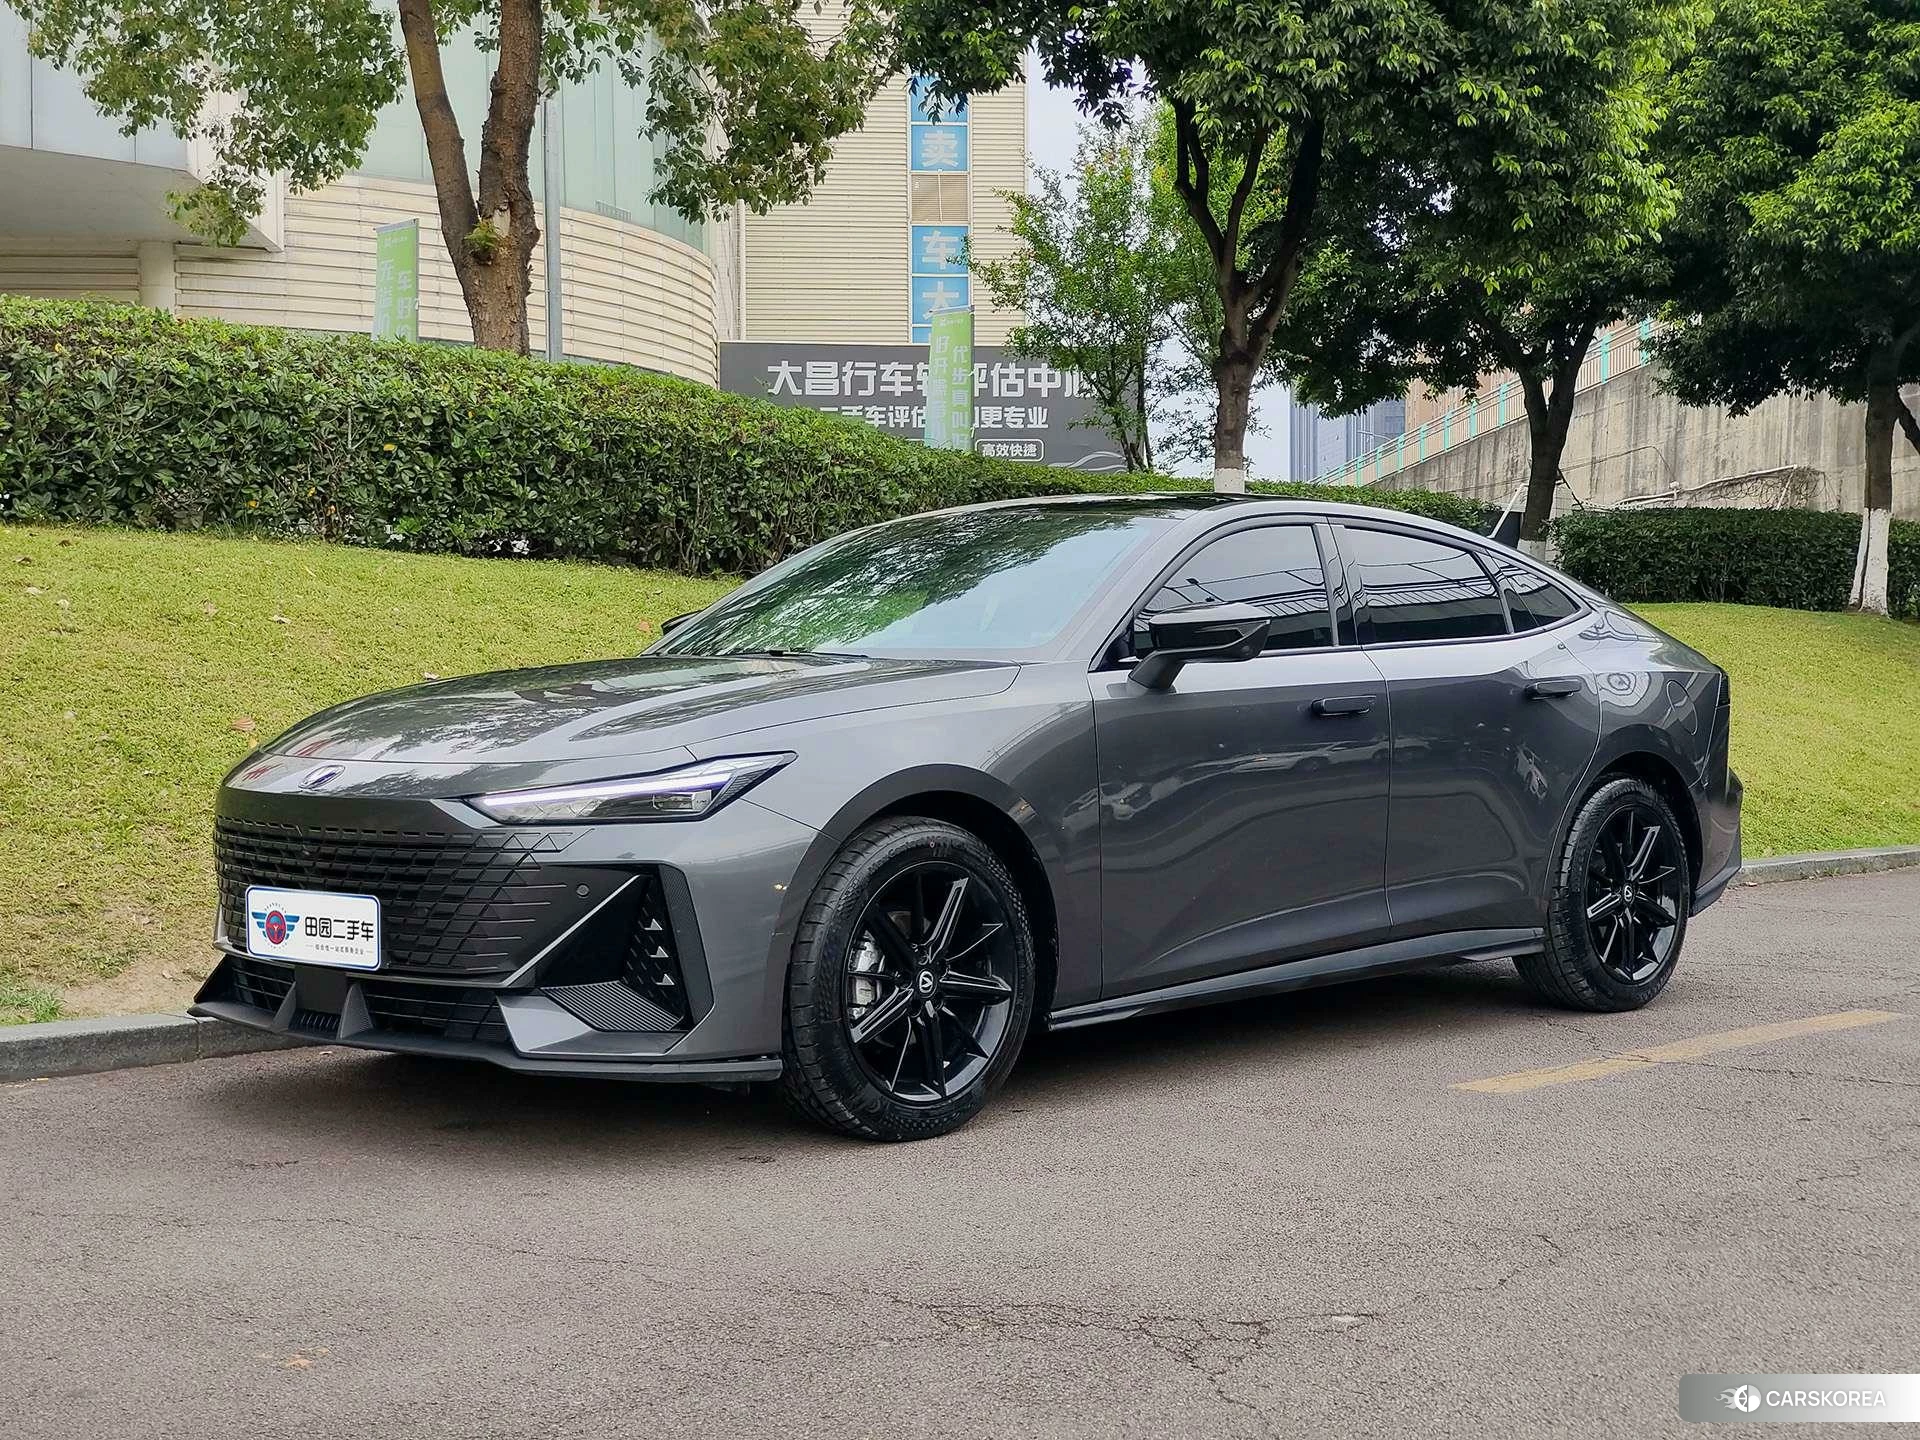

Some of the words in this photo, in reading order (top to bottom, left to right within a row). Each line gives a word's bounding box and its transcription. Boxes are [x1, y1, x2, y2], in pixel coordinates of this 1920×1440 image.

[981, 443, 1038, 459] 高效快捷
[305, 916, 374, 942] 田园二手车
